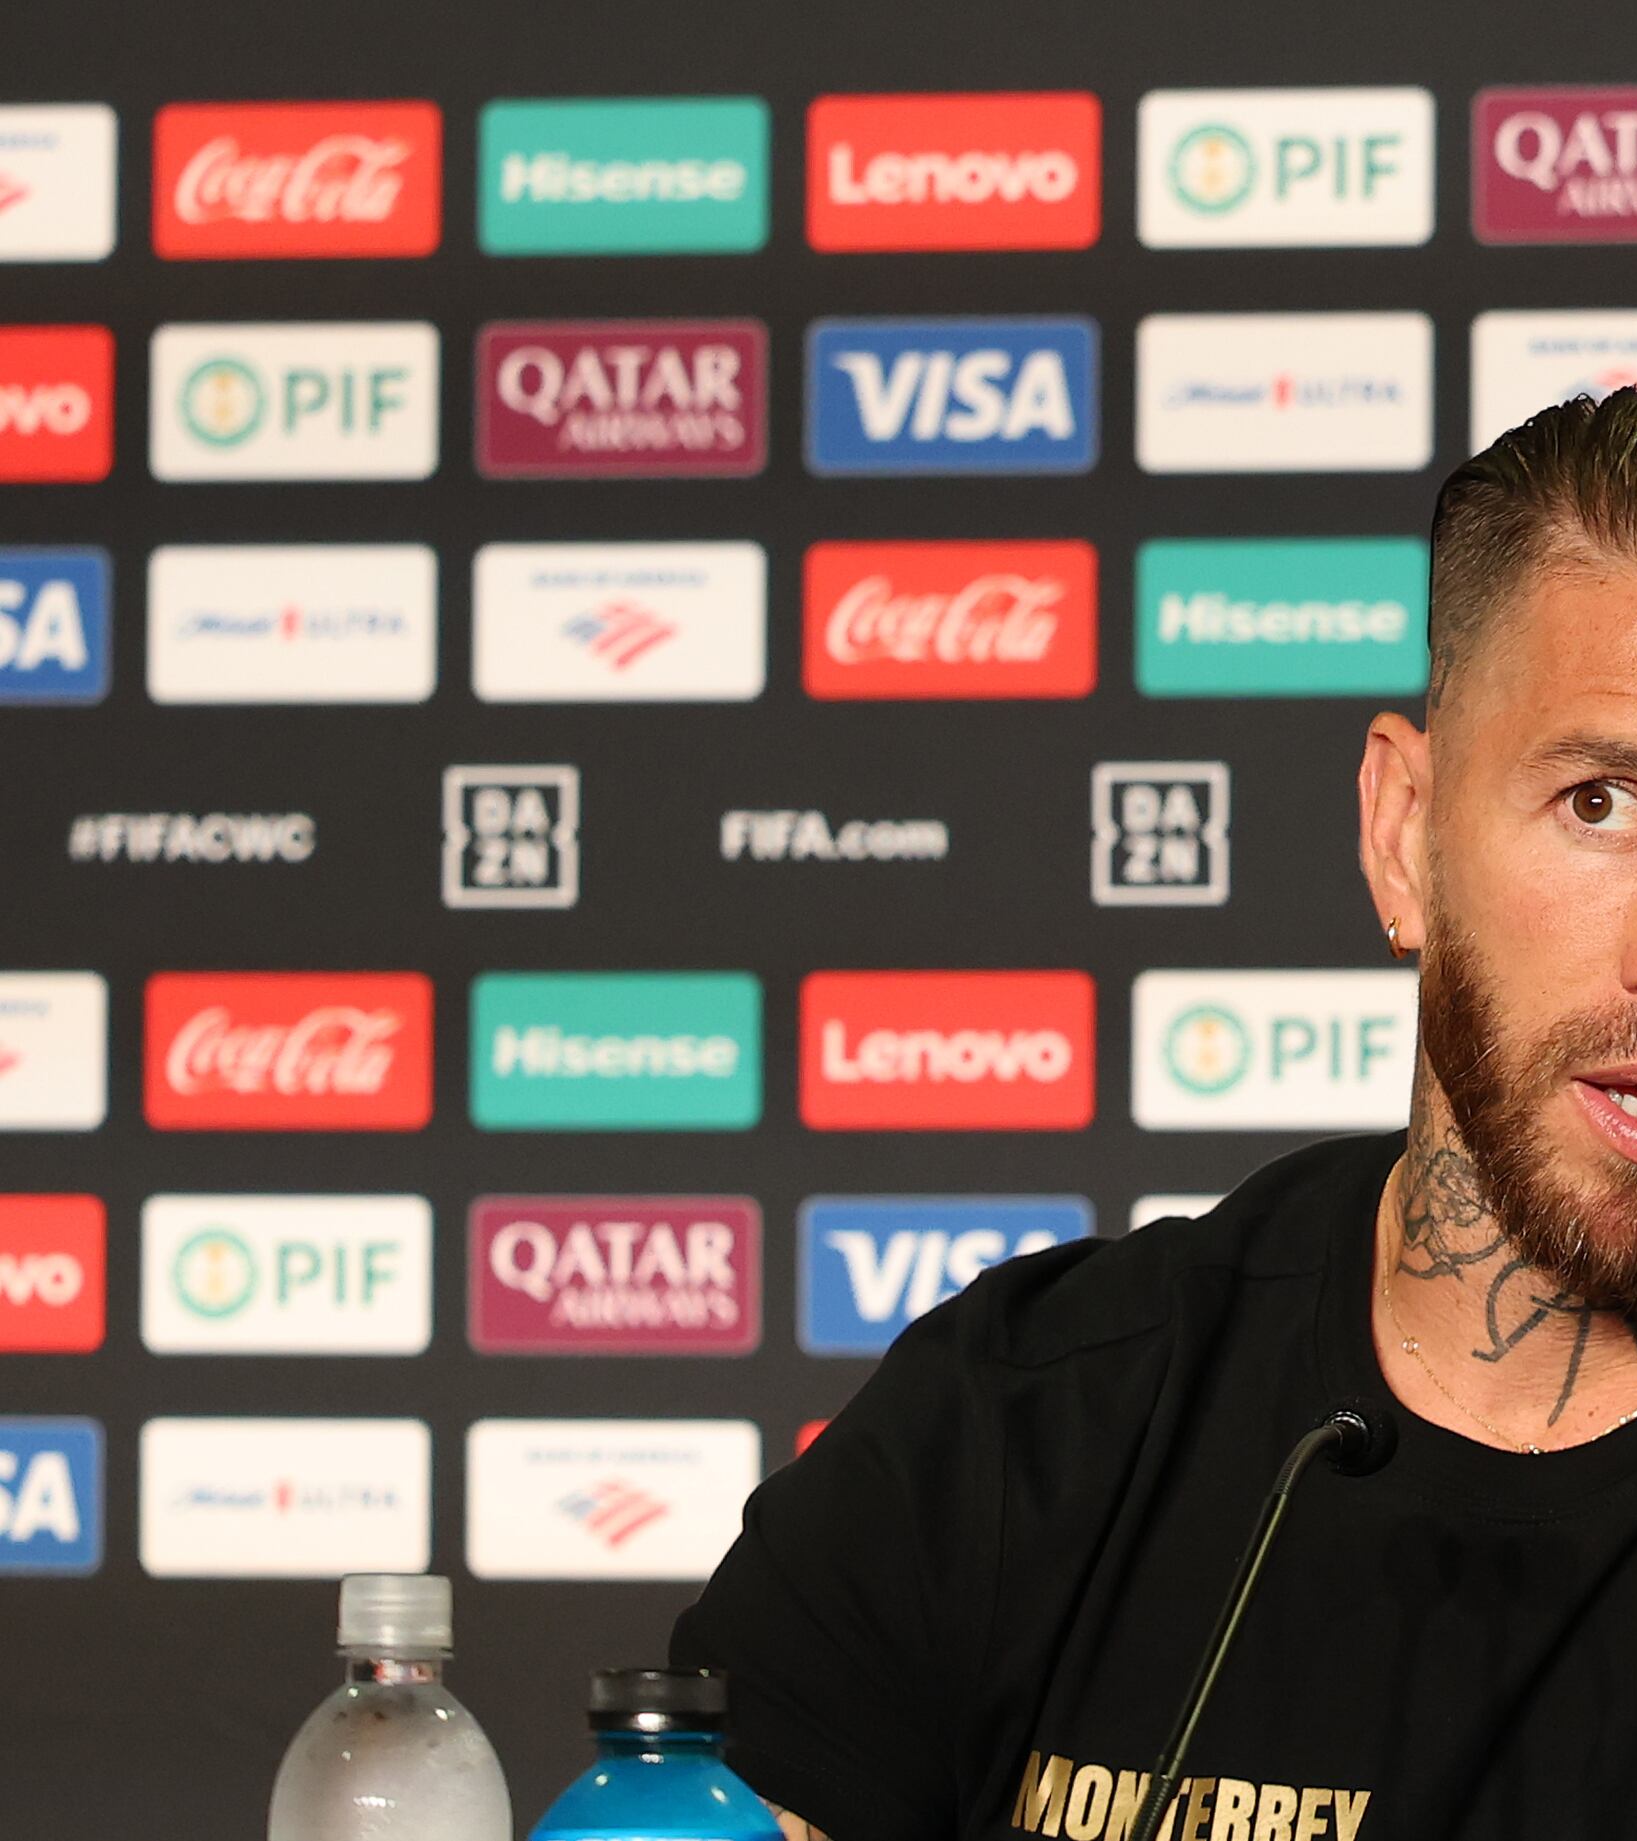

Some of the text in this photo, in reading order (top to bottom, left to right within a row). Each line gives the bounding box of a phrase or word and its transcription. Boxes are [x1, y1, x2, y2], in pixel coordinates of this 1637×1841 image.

[501, 154, 745, 201] Hisense
[829, 145, 1078, 204] Lenovo
[1274, 134, 1400, 200] PIF
[283, 368, 406, 433] PIF
[498, 347, 742, 424] QATAR
[839, 351, 1073, 440] VISA
[1159, 595, 1406, 642] Hisense
[71, 814, 313, 861] #FIFACWC
[722, 811, 947, 859] FIFA.com
[493, 1028, 737, 1076] Hisense
[823, 1022, 1071, 1082] Lenovo
[1270, 1016, 1395, 1080] PIF
[275, 1241, 396, 1305] PIF
[490, 1221, 736, 1302] QATAR
